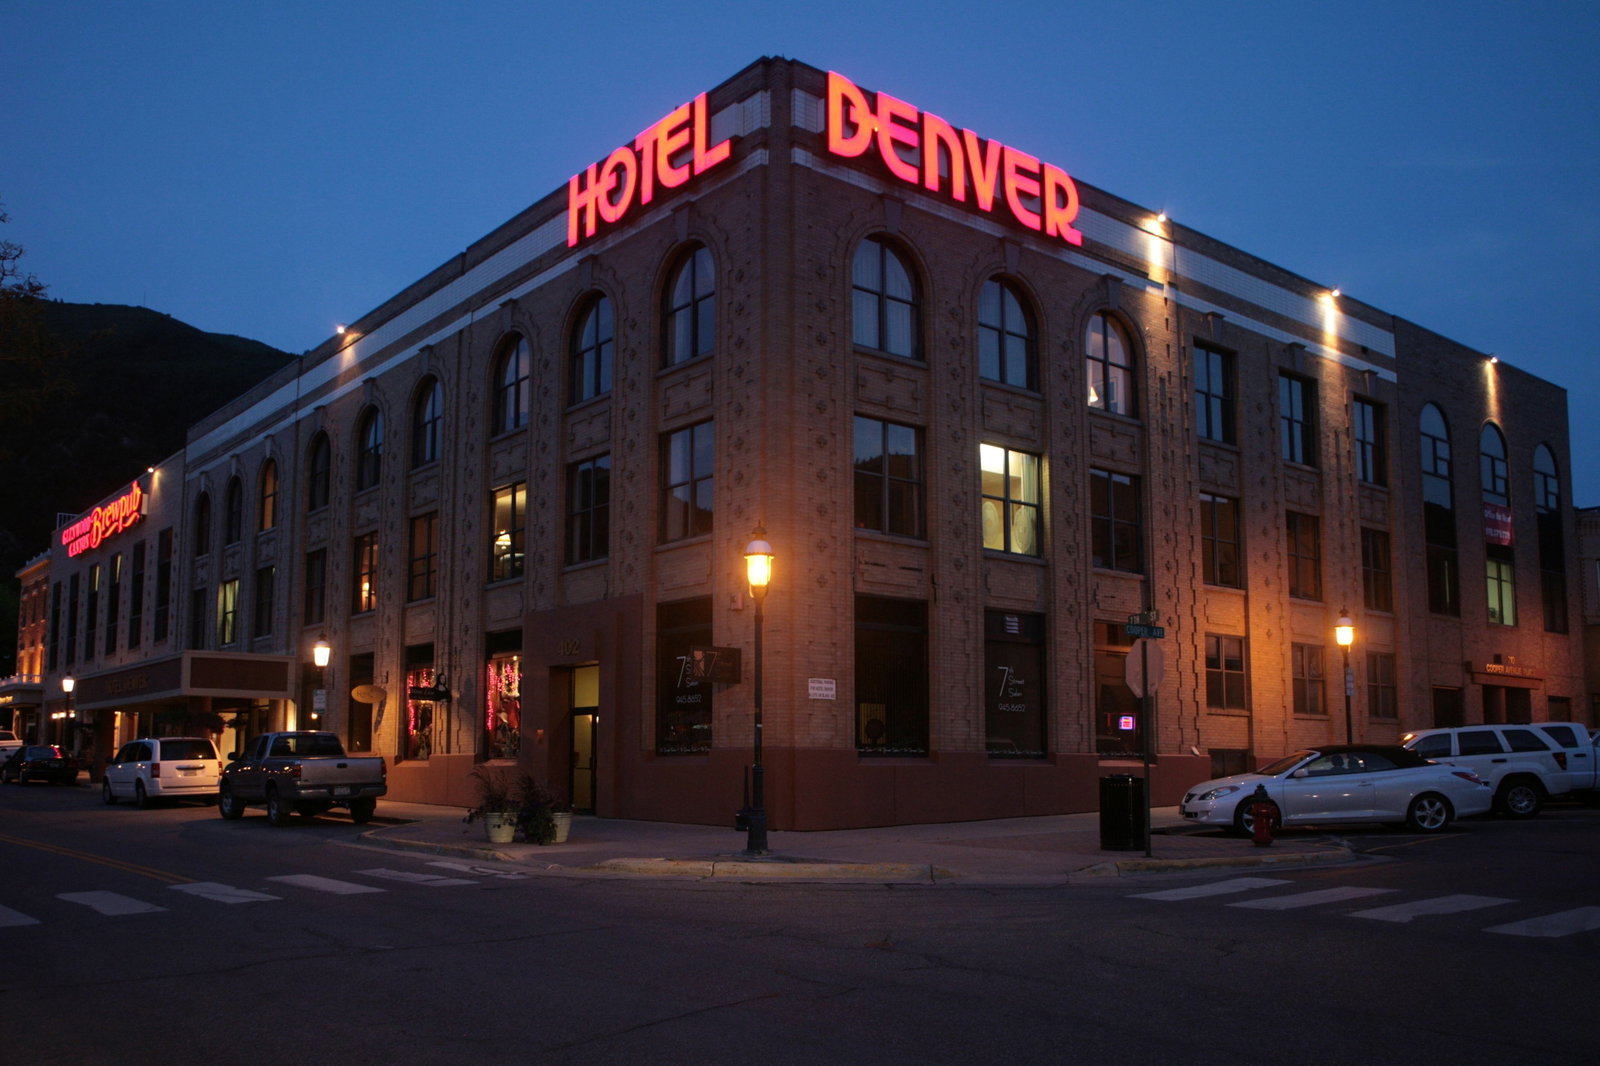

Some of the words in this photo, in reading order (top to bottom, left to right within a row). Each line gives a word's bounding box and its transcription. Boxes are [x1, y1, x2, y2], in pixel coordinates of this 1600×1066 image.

[568, 91, 731, 247] HOTEL
[828, 70, 1083, 247] DENVER
[90, 480, 141, 548] Brewpub
[1126, 625, 1149, 638] COOPER
[1153, 628, 1164, 638] AVE
[1486, 663, 1505, 674] COOPER
